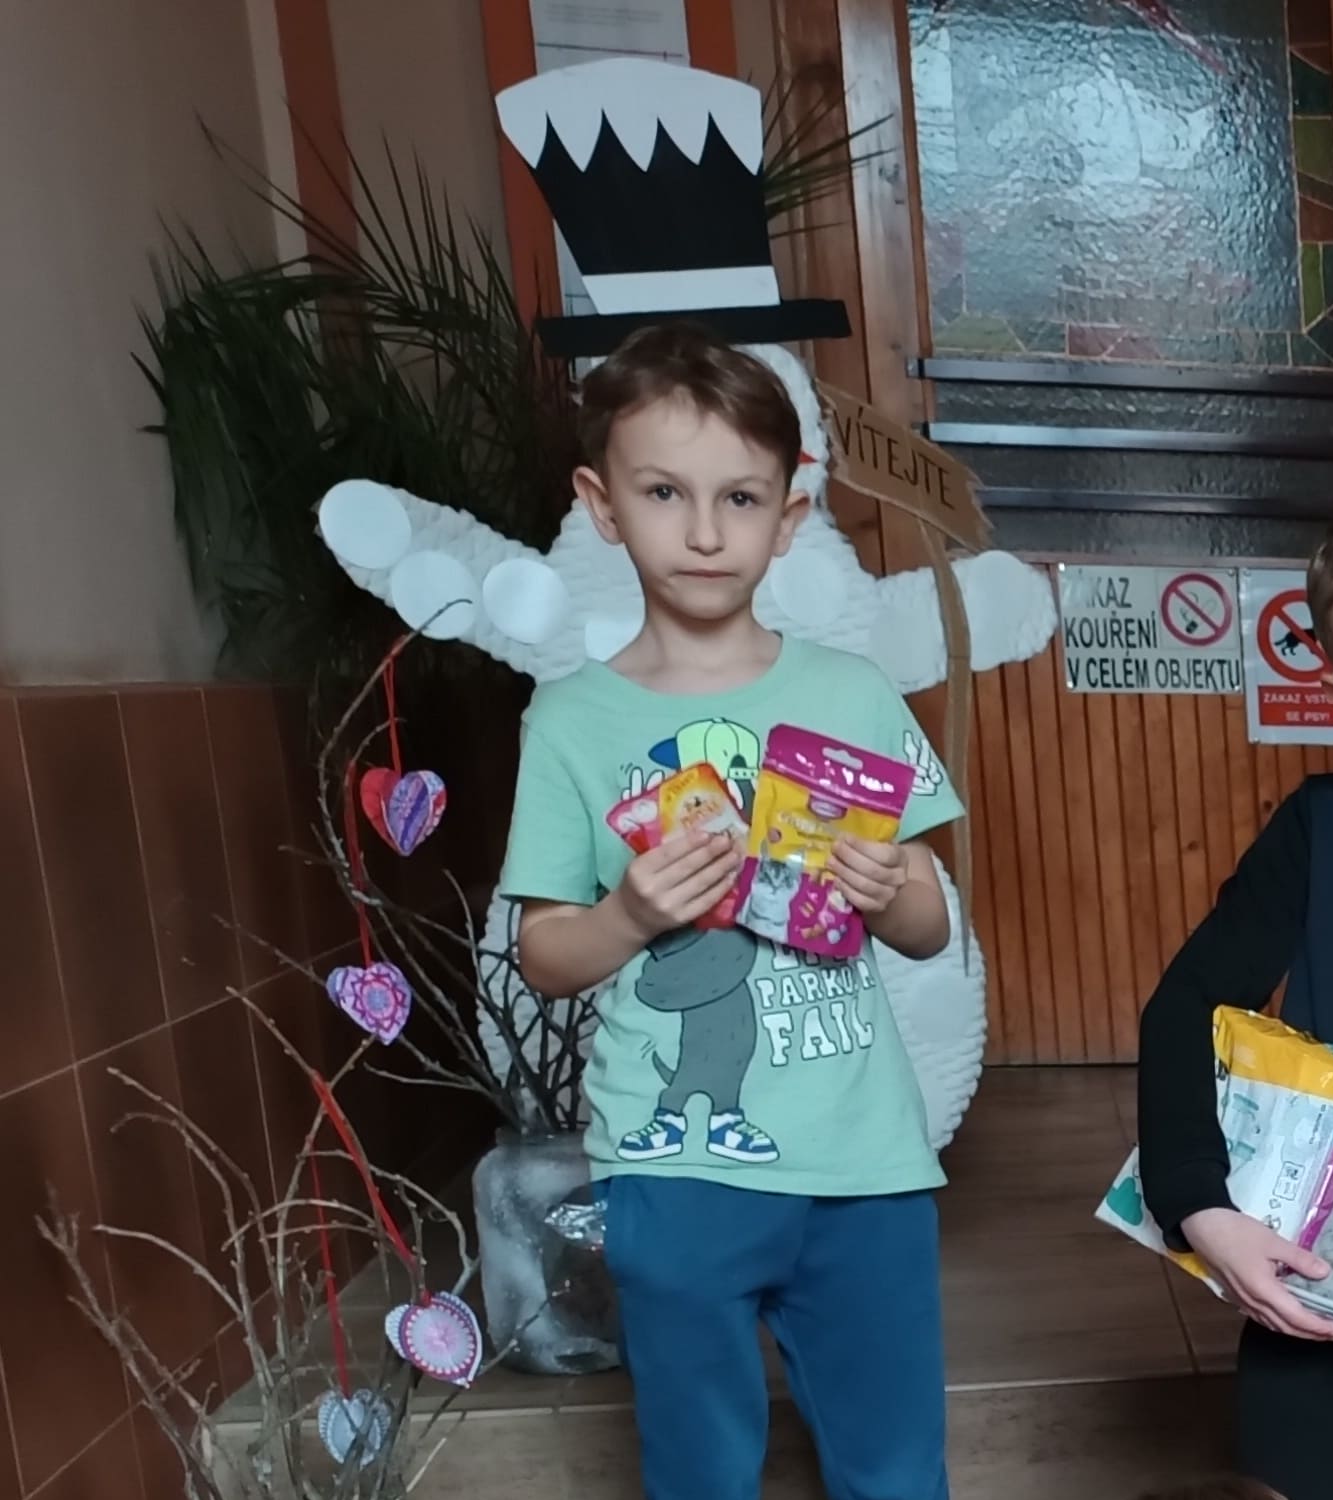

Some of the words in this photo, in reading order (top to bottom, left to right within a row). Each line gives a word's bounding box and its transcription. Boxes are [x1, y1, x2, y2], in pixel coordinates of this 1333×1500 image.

[833, 406, 955, 510] VÍTEJTE
[1064, 610, 1158, 649] KOUŘENÍ
[1067, 657, 1080, 688] V
[1085, 650, 1150, 688] CELÉM
[1155, 658, 1240, 691] OBJEKTU
[761, 999, 875, 1067] FAIL
